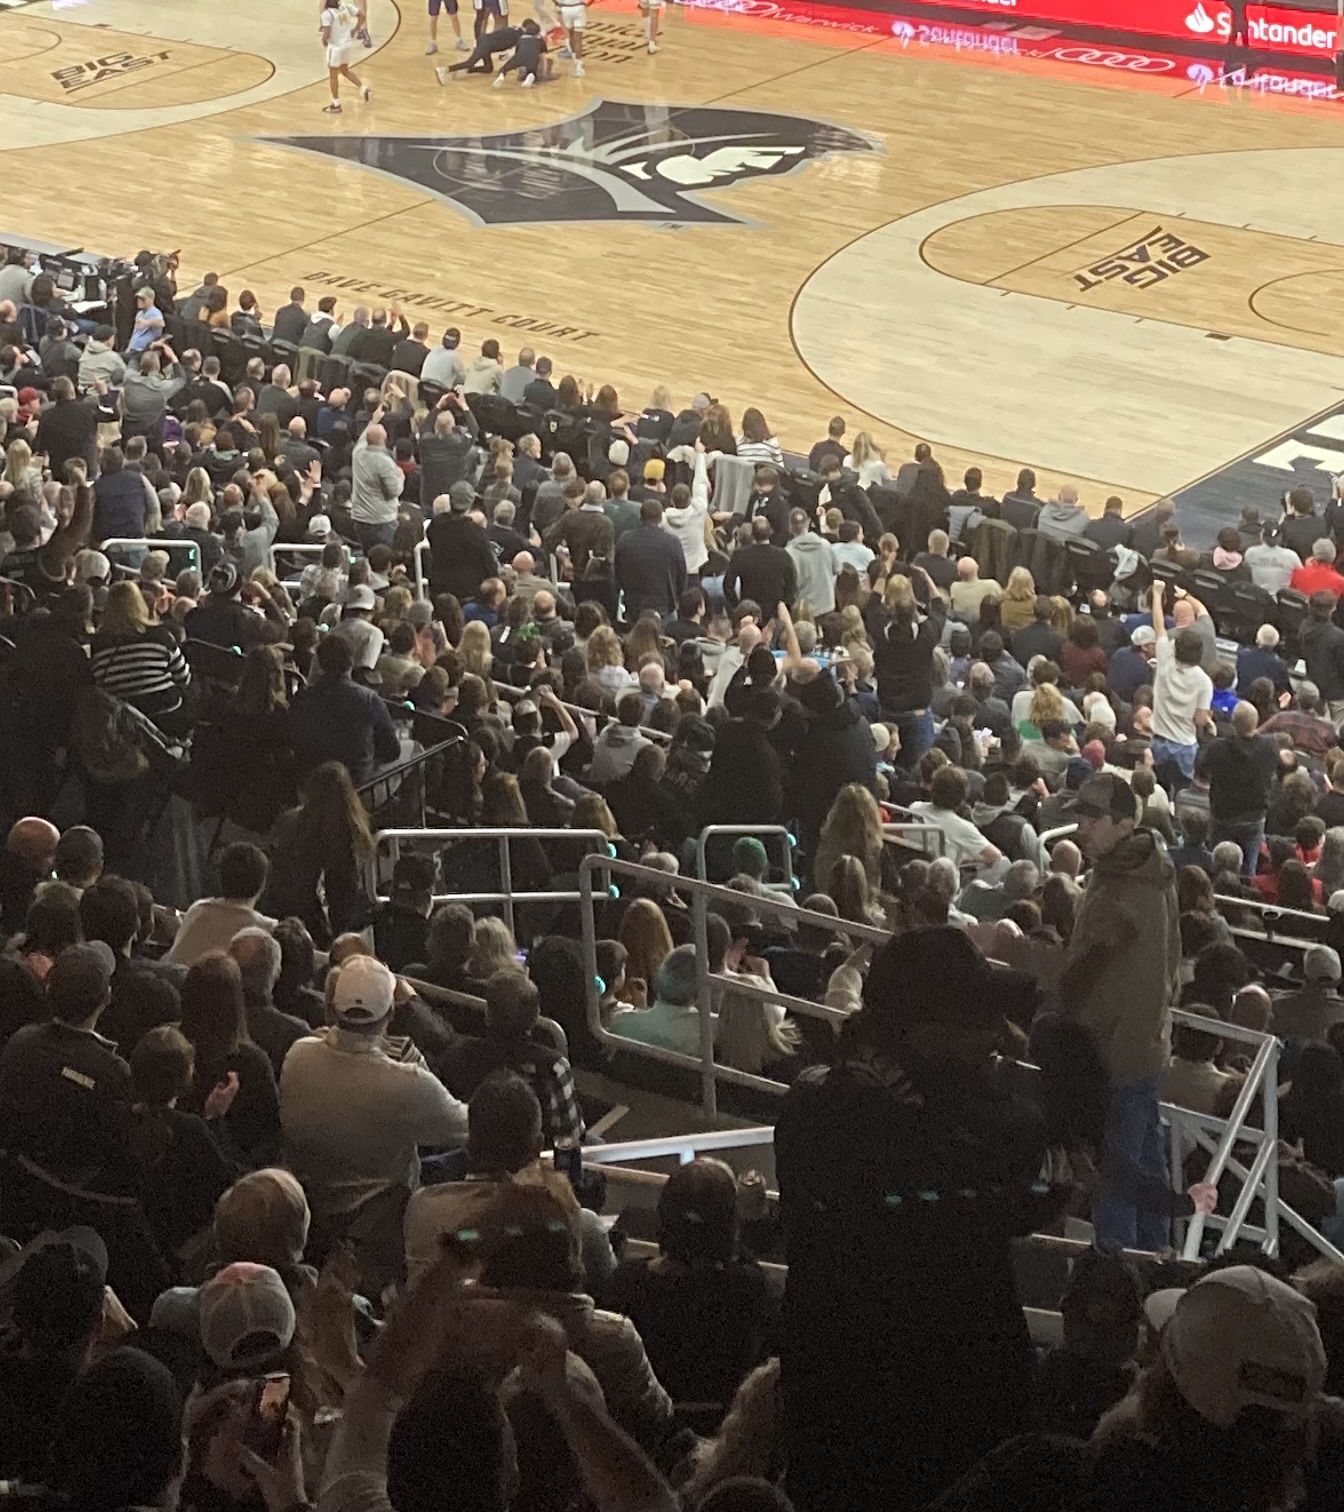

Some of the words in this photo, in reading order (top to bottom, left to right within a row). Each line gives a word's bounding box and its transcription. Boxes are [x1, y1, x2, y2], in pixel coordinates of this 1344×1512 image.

[1217, 12, 1337, 49] Sntander
[50, 51, 132, 80] BIG
[61, 49, 174, 90] EAST
[1072, 232, 1187, 293] EAST
[1123, 245, 1212, 290] BIG
[302, 271, 382, 293] DAVE
[378, 288, 494, 318] GAVITT
[493, 314, 602, 342] COURT
